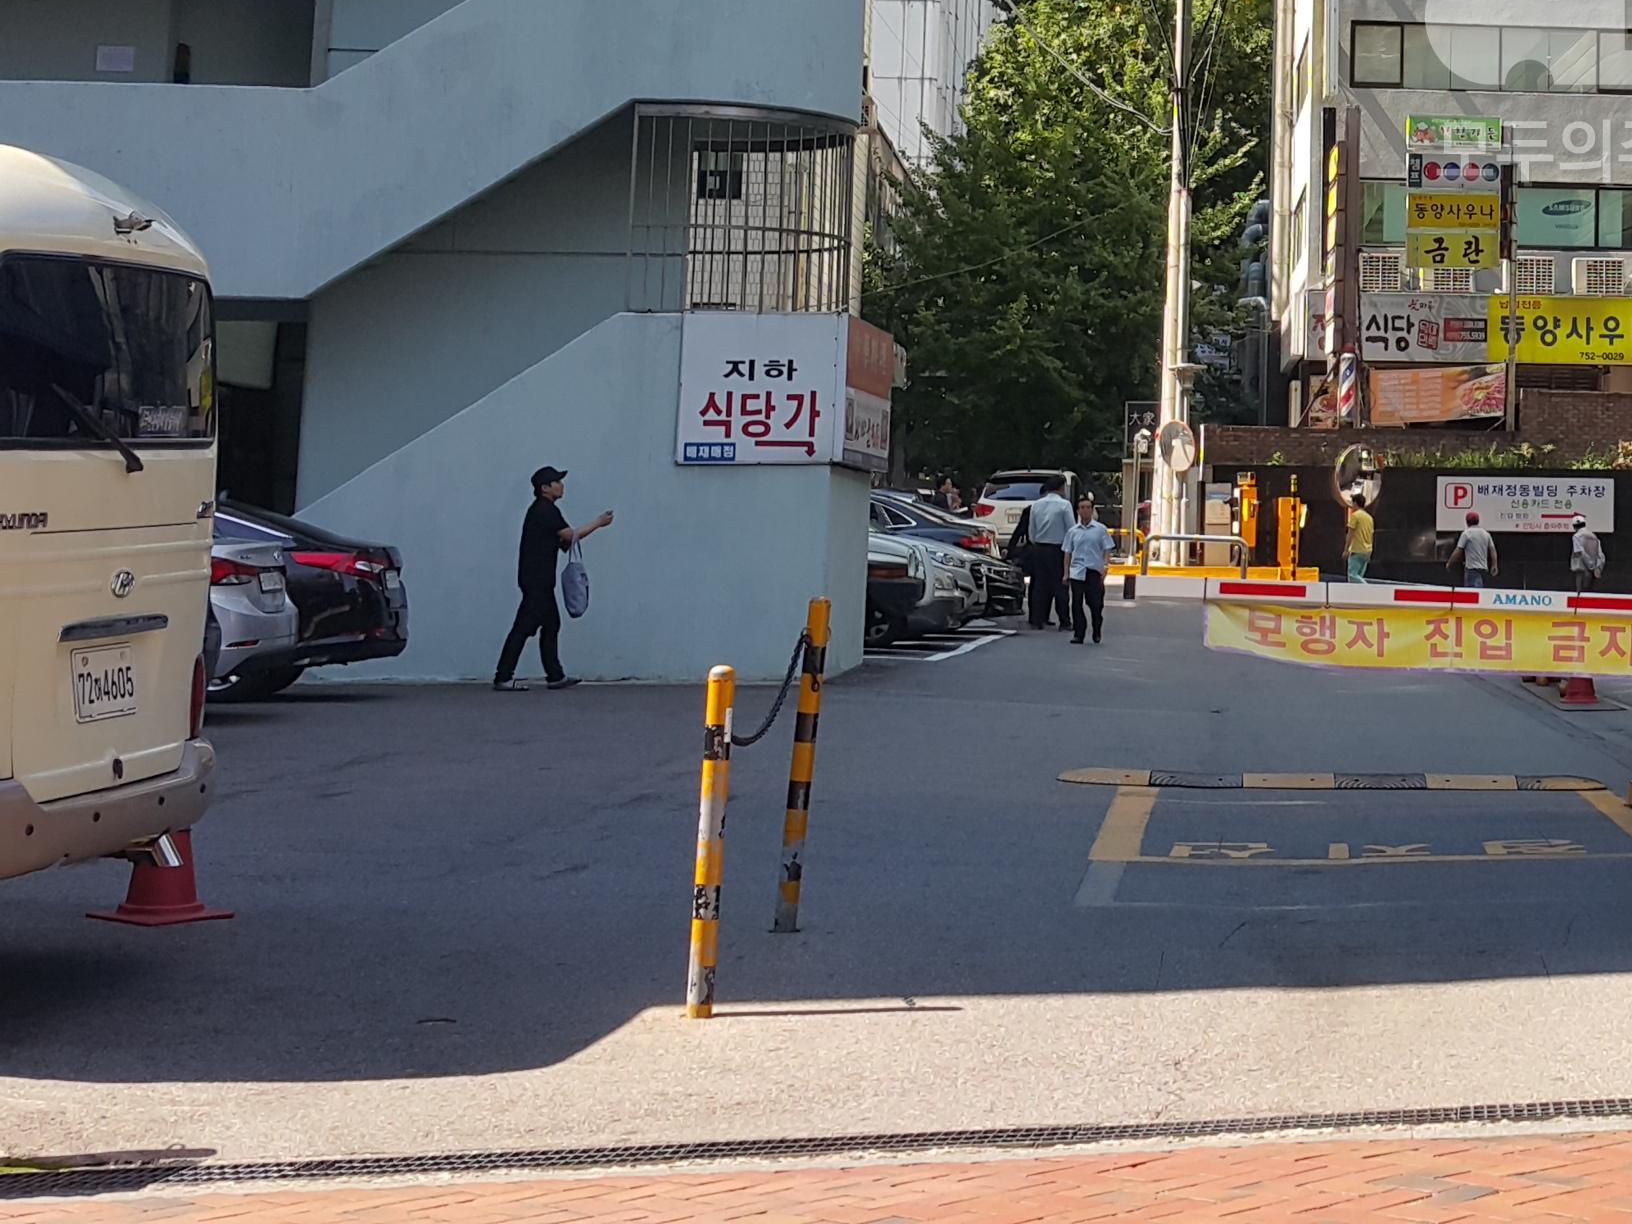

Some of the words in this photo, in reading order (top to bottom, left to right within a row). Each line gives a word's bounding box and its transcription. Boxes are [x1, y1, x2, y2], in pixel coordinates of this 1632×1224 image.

[1414, 203, 1495, 220] 동양사우나
[1365, 314, 1415, 352] 식당
[1579, 352, 1624, 361] 752-0029
[722, 358, 798, 381] 지하
[699, 390, 821, 439] 식당가
[1129, 411, 1155, 426] 大家
[1454, 485, 1468, 506] P
[1567, 484, 1606, 498] 주차장
[1492, 593, 1552, 607] AMANO
[1245, 608, 1390, 658] 보행자
[1423, 615, 1514, 662] 진입
